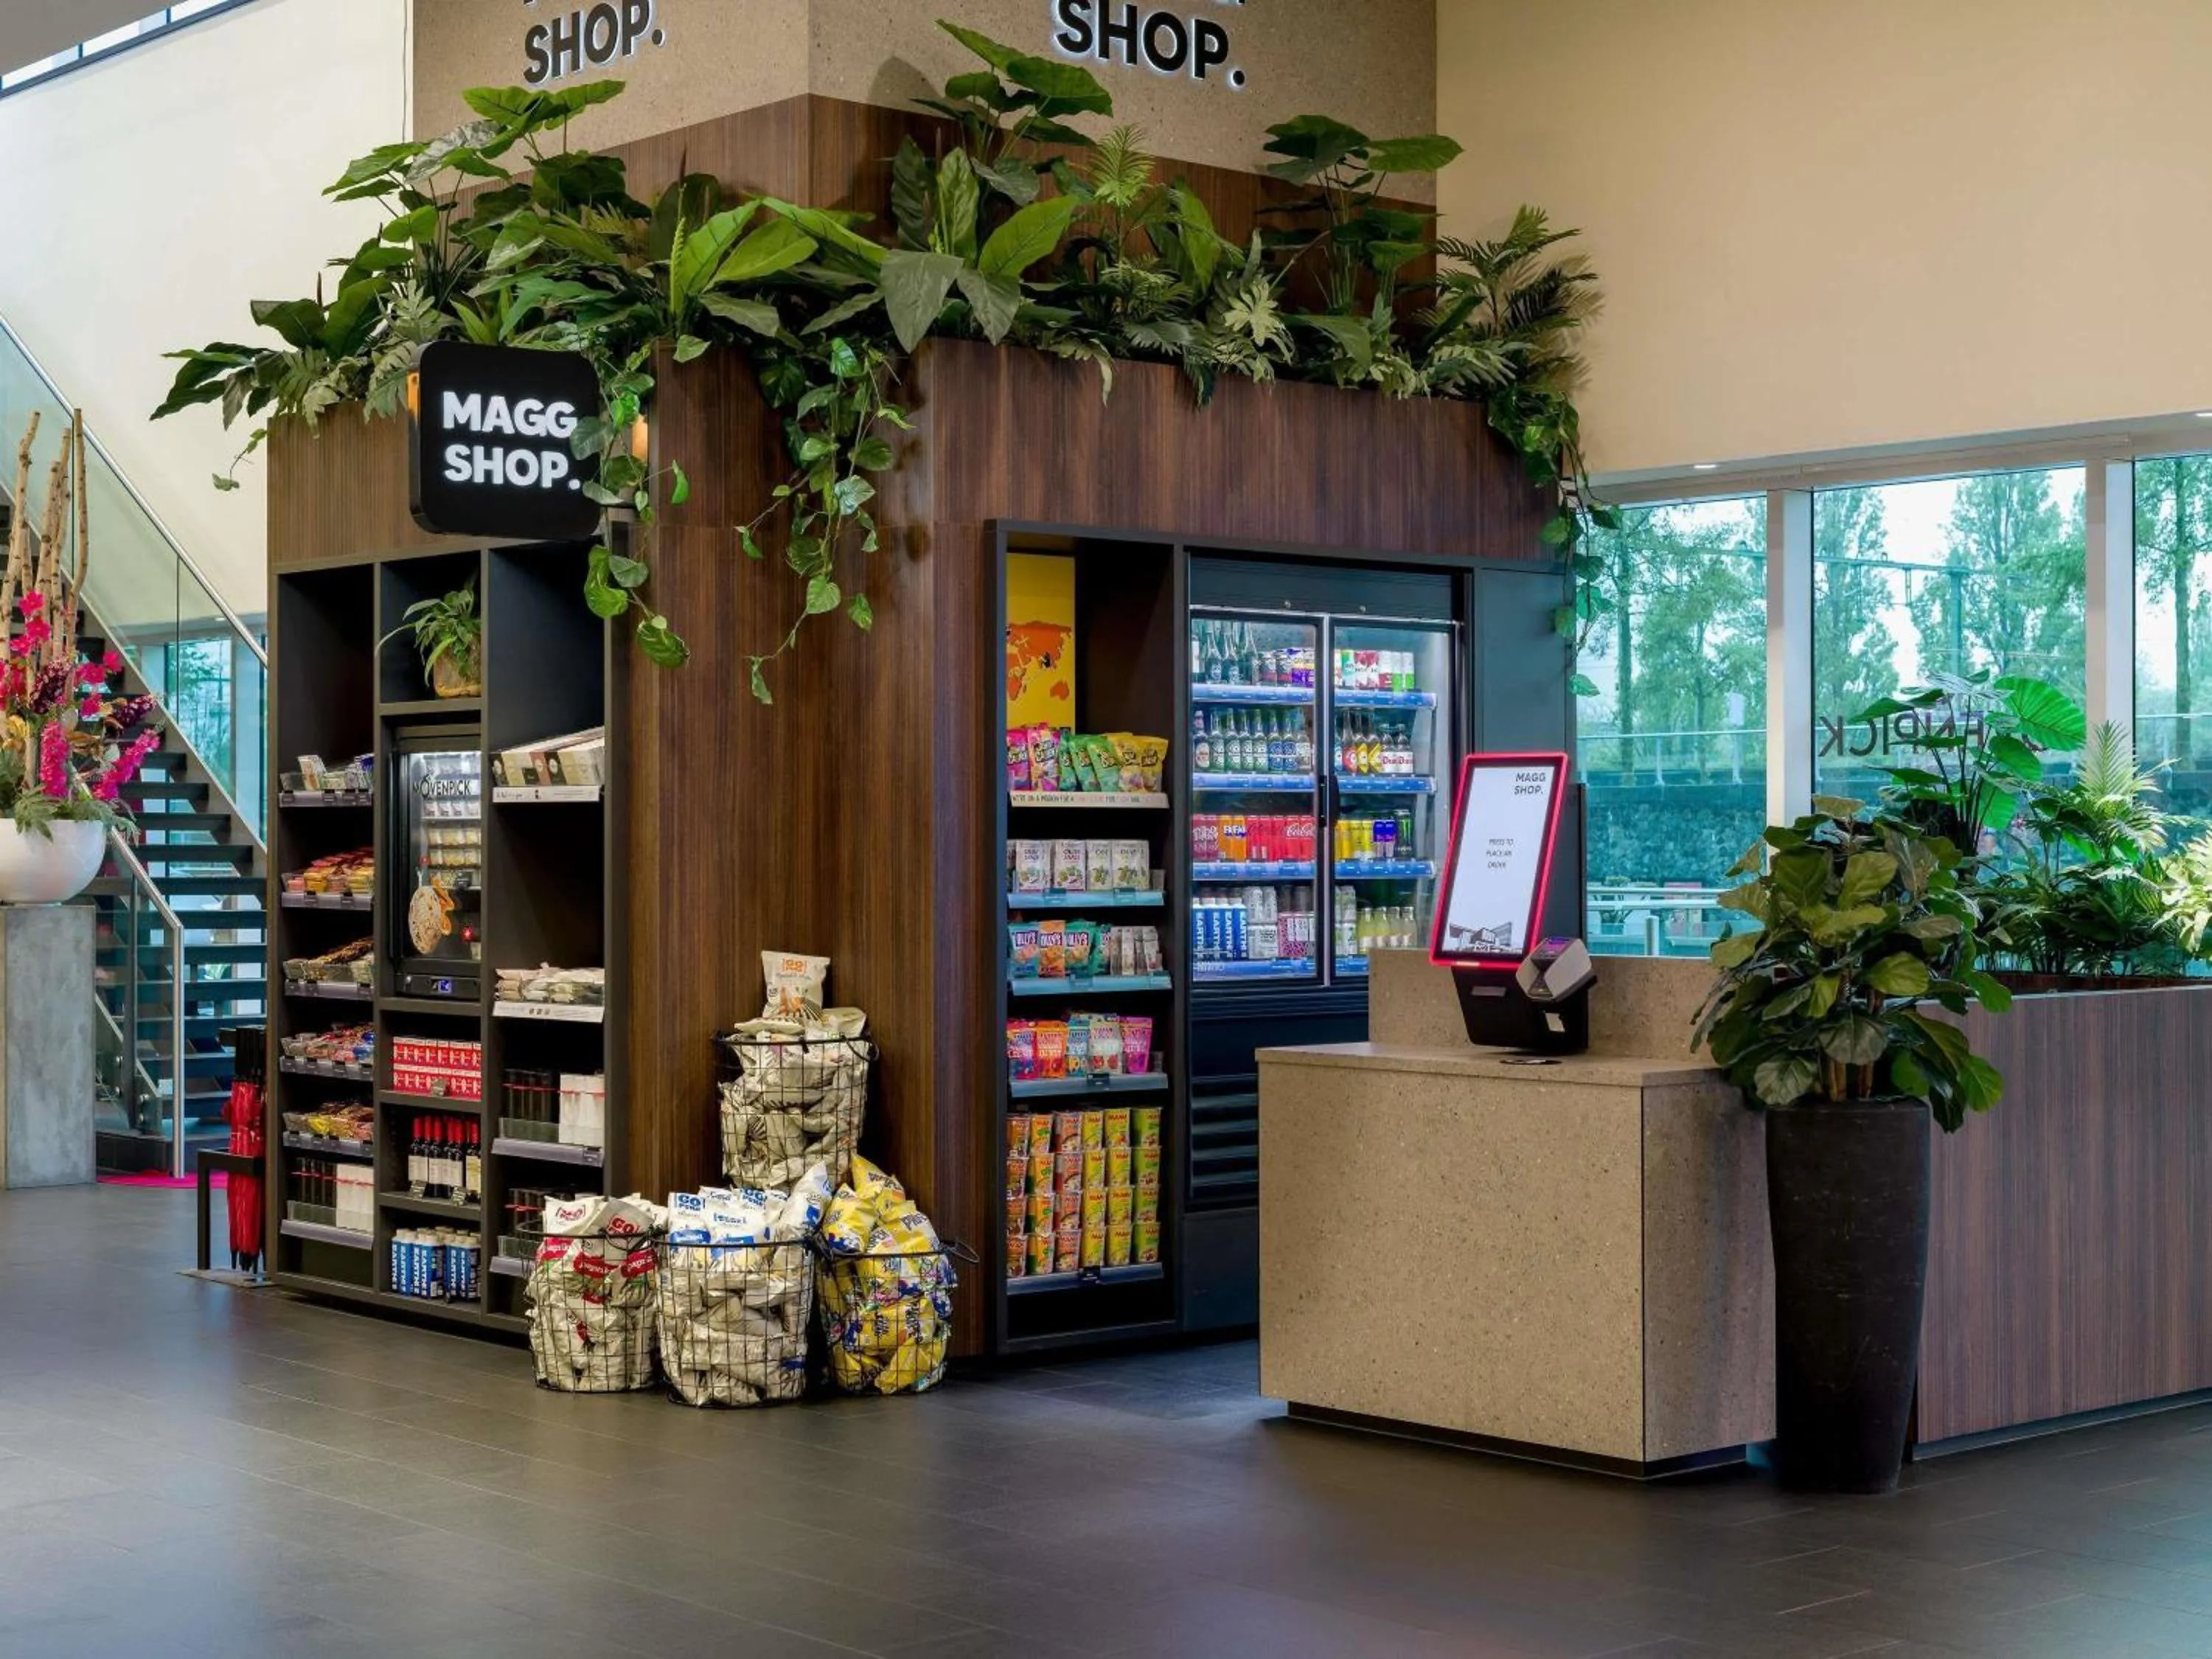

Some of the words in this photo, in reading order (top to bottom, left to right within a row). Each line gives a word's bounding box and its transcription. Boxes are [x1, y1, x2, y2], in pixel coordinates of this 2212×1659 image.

[523, 0, 665, 84] SHOP.
[1054, 0, 1246, 87] SHOP.
[442, 391, 577, 439] MAGG
[444, 444, 581, 490] SHOP.
[1514, 785, 1543, 795] SHOP.
[1515, 772, 1545, 782] MAGG
[678, 1194, 701, 1207] GO
[611, 1217, 636, 1233] GO
